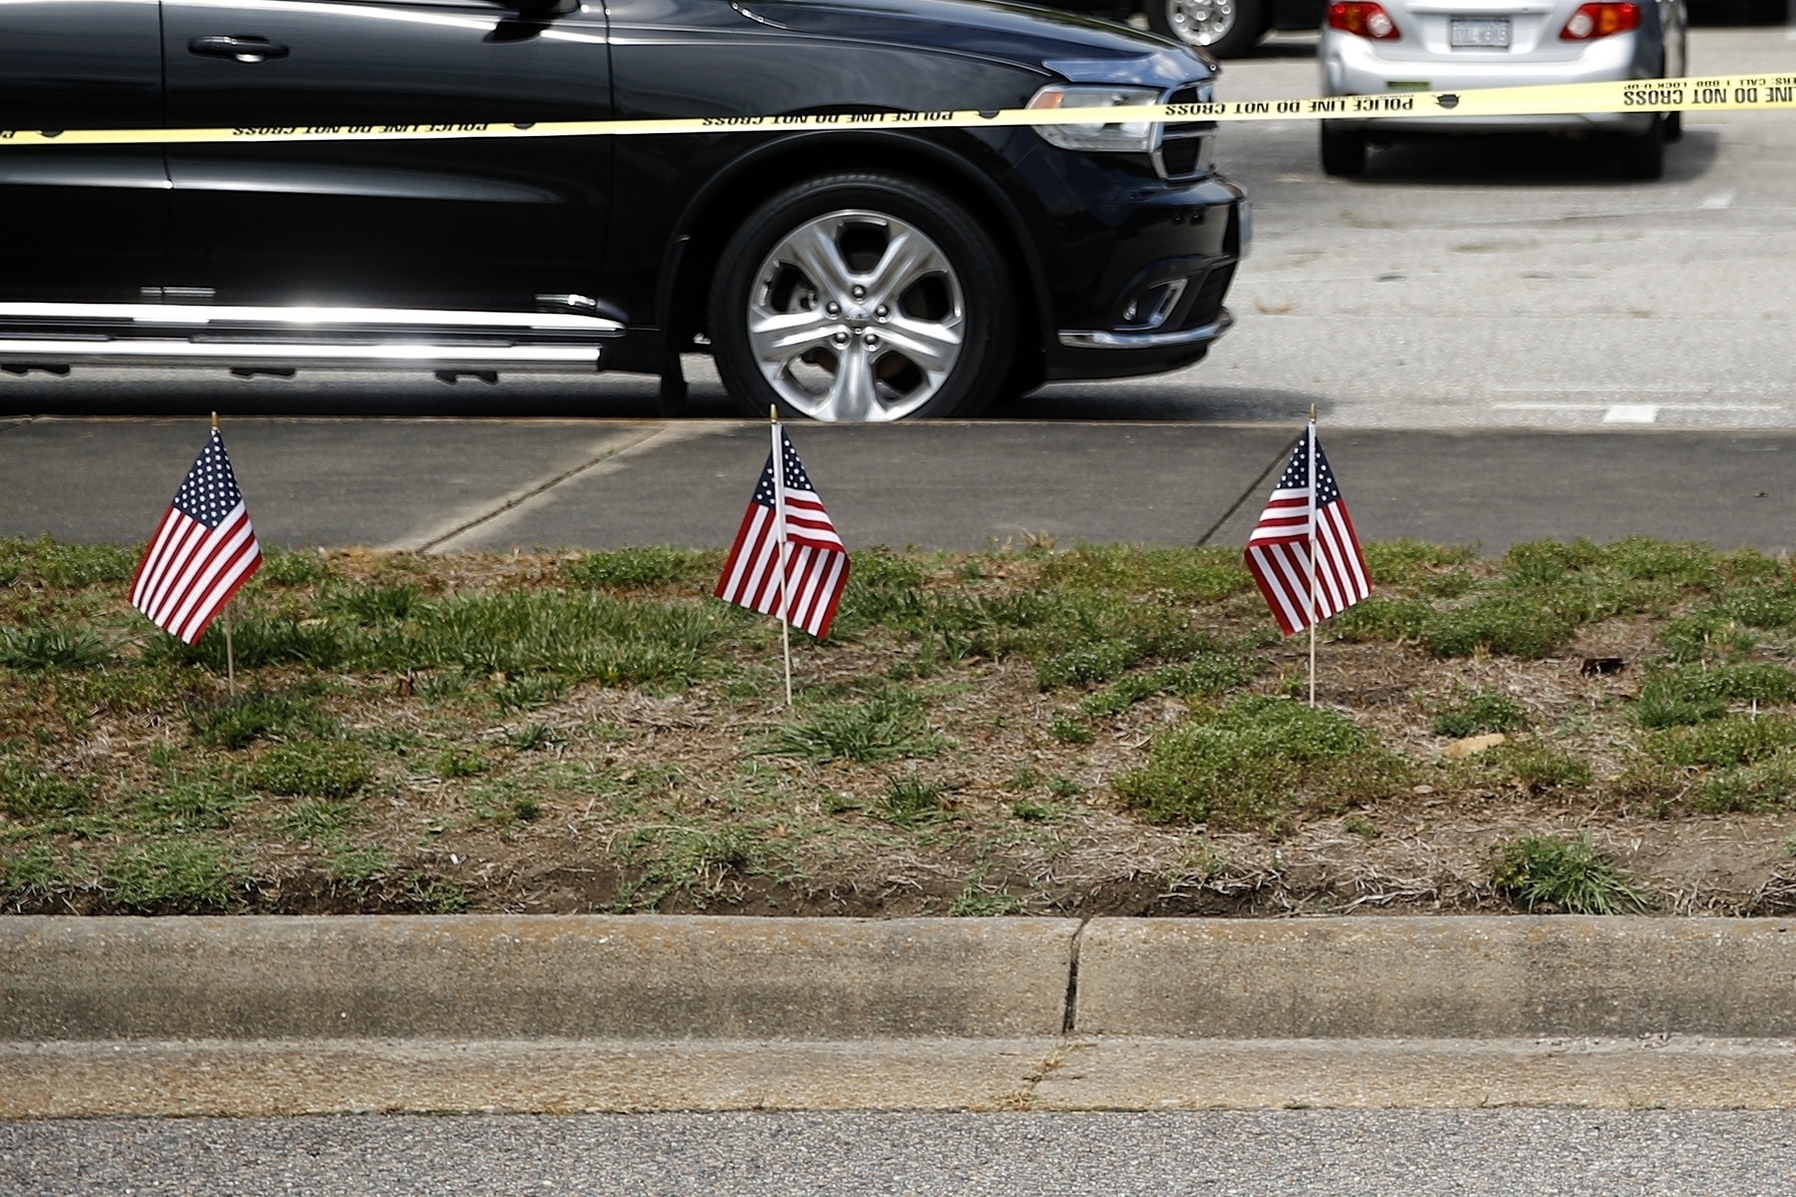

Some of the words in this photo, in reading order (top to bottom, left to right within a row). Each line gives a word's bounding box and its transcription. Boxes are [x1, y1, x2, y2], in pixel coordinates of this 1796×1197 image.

[1739, 78, 1765, 86] CALL
[1624, 90, 1683, 106] CROSS
[1692, 88, 1726, 104] NOT
[1735, 87, 1757, 103] DO
[1165, 104, 1225, 115] CROSS
[1234, 103, 1269, 114] NOT
[1278, 101, 1300, 113] DO
[1309, 100, 1345, 112] LINE
[1353, 98, 1413, 111] POLICE
